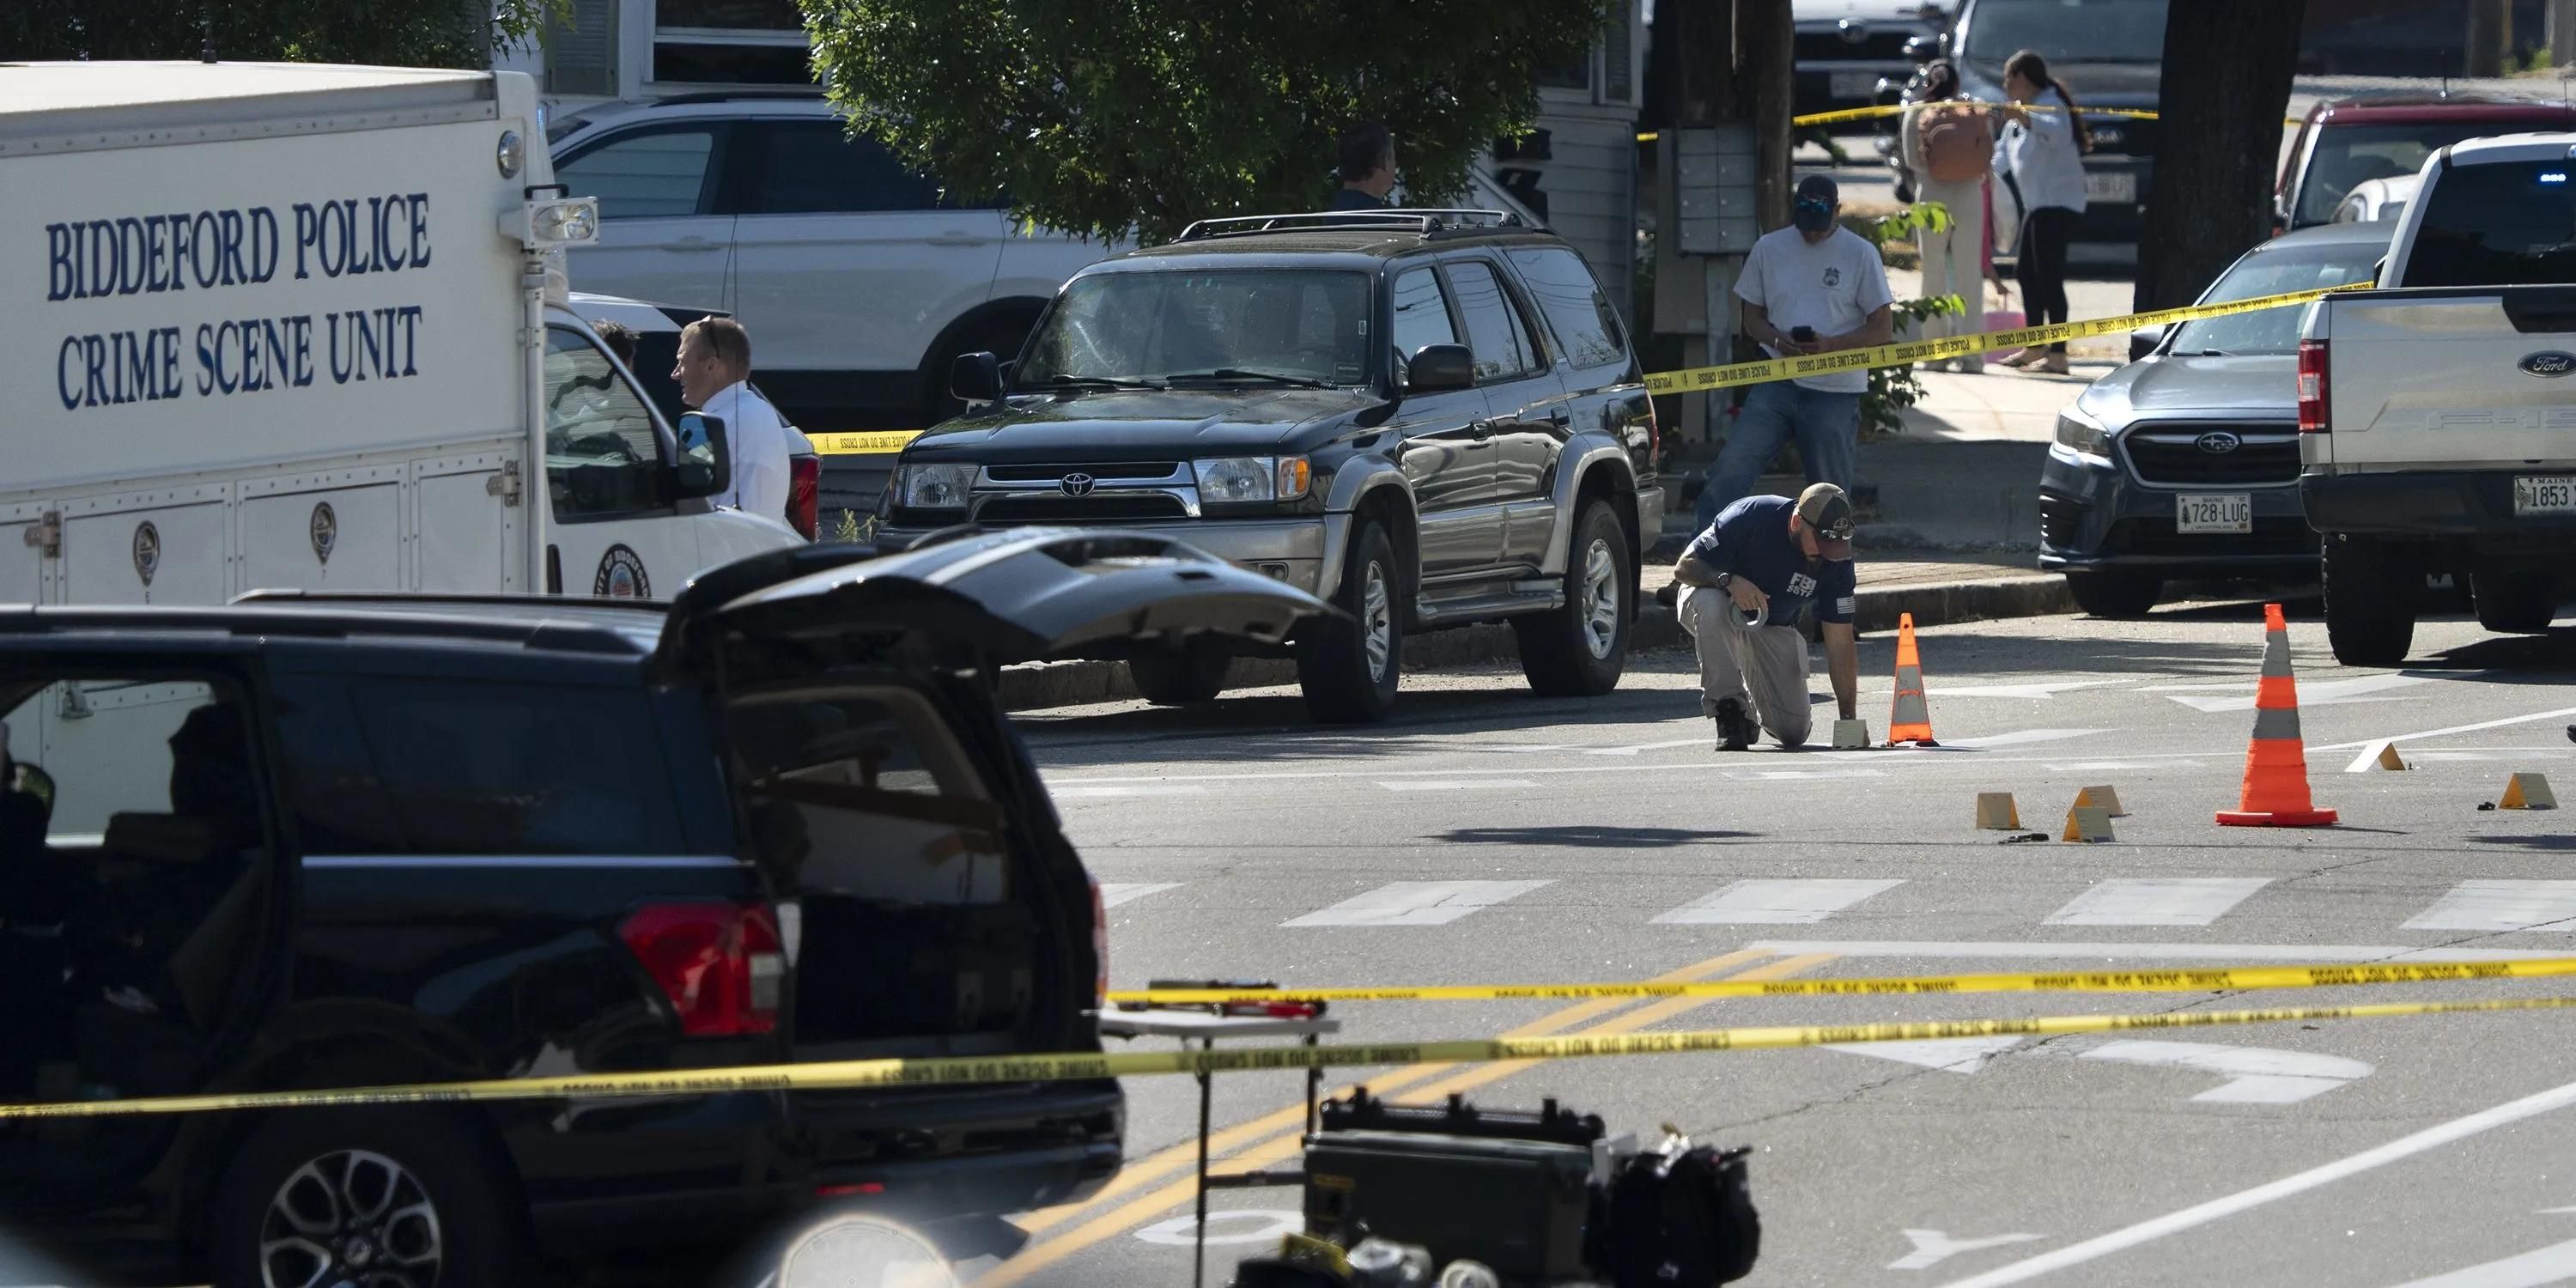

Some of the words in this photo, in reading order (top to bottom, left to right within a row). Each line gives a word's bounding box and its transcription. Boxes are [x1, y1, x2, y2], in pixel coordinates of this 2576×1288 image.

[46, 206, 279, 301] BIDDEFORD
[292, 192, 431, 280] POLICE
[2015, 332, 2026, 343] NOT
[2027, 331, 2036, 342] DO
[2037, 329, 2050, 341] LINE
[2050, 325, 2071, 338] POLICE
[1949, 339, 1971, 352] POLICE
[1996, 333, 2014, 346] CROSS
[1896, 347, 1915, 360] CROSS
[1916, 345, 1927, 357] NOT
[1928, 343, 1935, 355] DO
[1936, 342, 1949, 354] LINE
[58, 326, 184, 410] CRIME
[195, 315, 314, 397] SCENE
[325, 305, 422, 385] UNIT
[1828, 357, 1836, 368] DO
[1838, 355, 1850, 368] LINE
[1850, 352, 1870, 365] POLICE
[2533, 356, 2568, 371] Ford
[1796, 360, 1815, 373] CROSS
[1816, 358, 1827, 370] NOT
[1717, 370, 1728, 382] NOT
[1729, 369, 1738, 380] DO
[1738, 368, 1751, 380] LINE
[1751, 365, 1771, 379] POLICE
[1653, 377, 1673, 390] POLICE
[1698, 372, 1716, 385] CROSS
[840, 438, 858, 449] CROSS
[858, 438, 870, 449] NOT
[870, 437, 878, 448] DO
[878, 437, 891, 448] LINE
[2531, 486, 2568, 507] 1853
[1790, 572, 1817, 591] FBI
